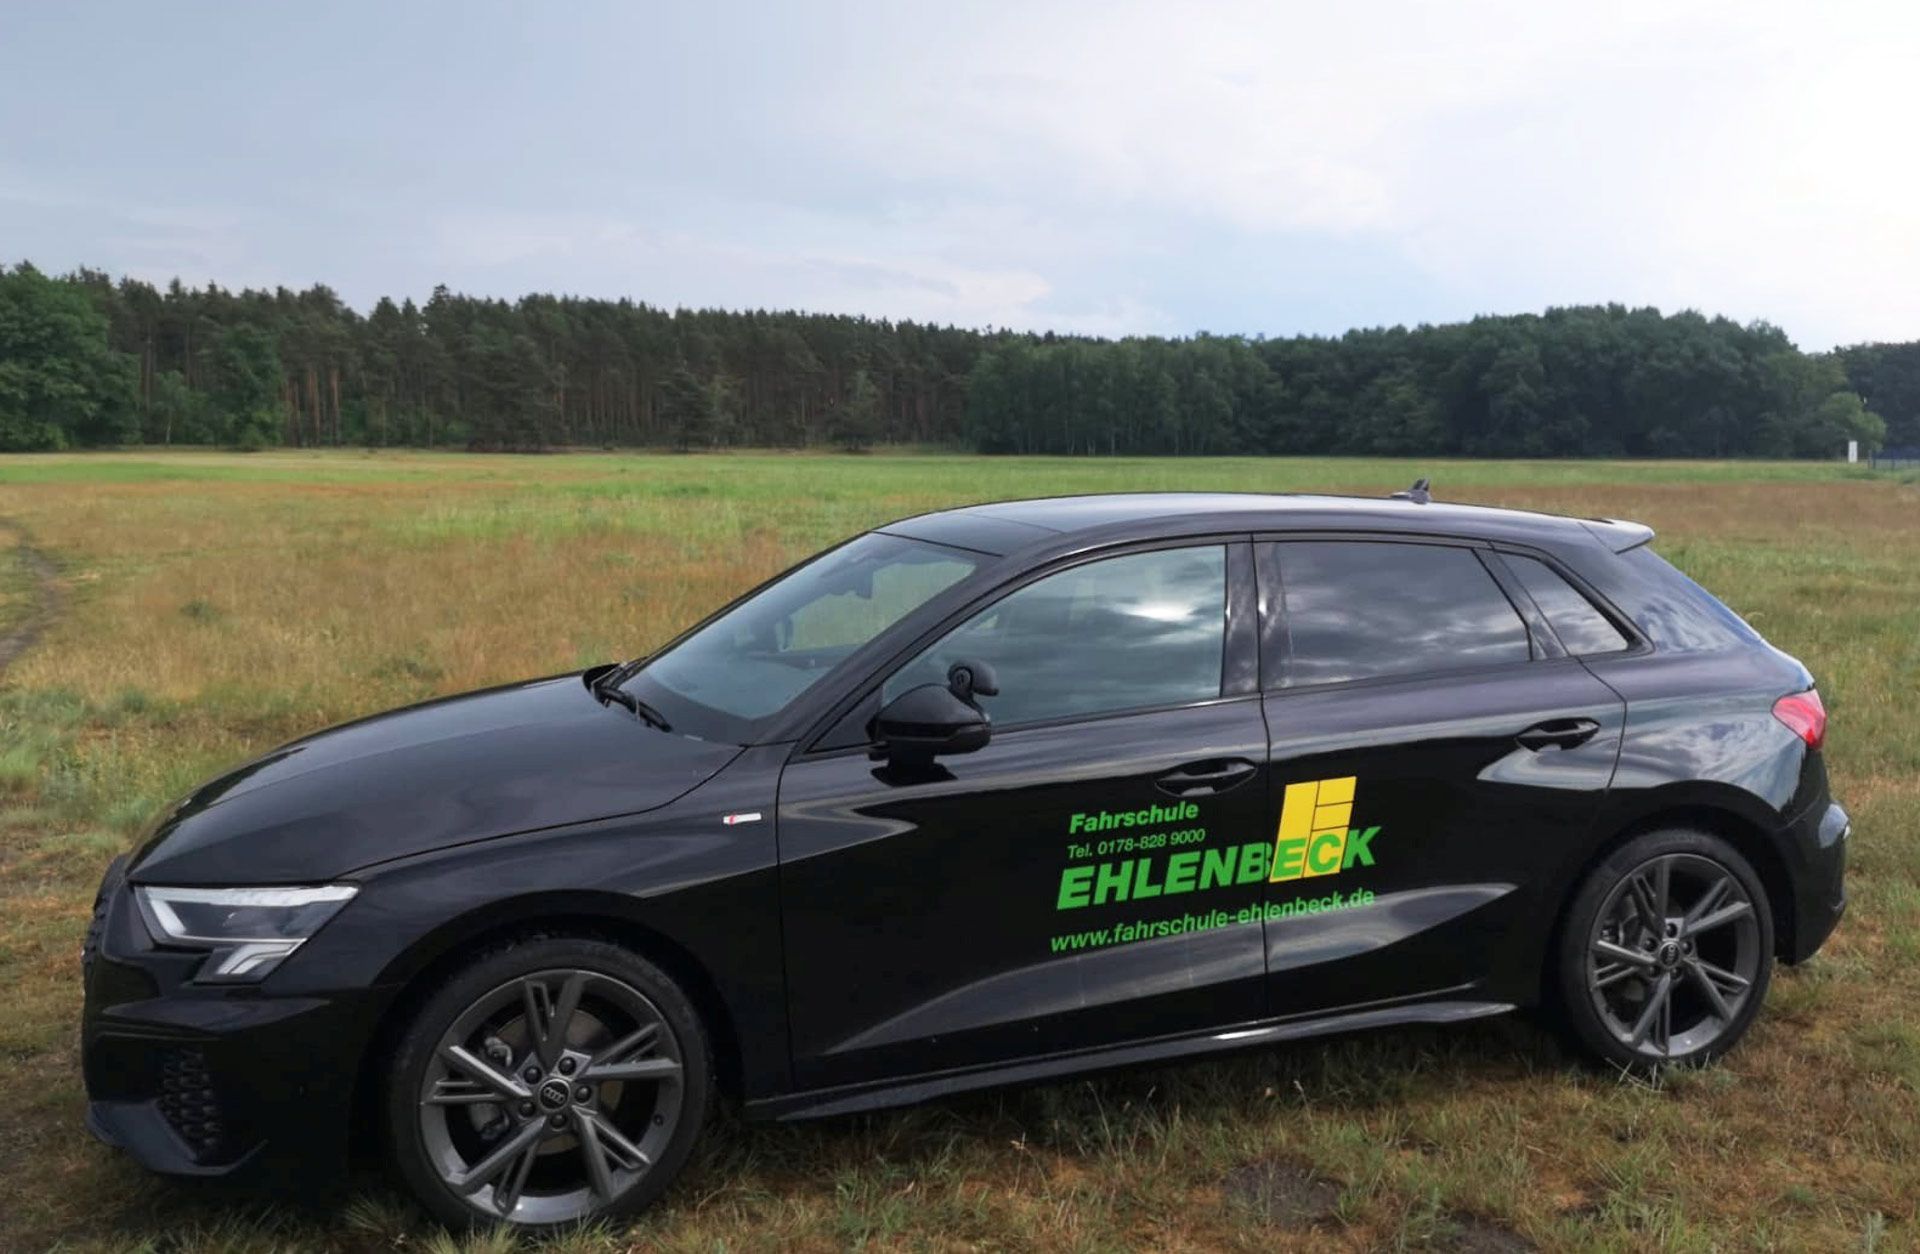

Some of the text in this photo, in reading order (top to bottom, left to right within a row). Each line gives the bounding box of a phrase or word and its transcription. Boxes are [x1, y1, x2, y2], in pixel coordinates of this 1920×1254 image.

[1069, 801, 1199, 834] Fahrschule
[1057, 826, 1381, 910] EHLENBECK
[1067, 829, 1206, 859] Tel. 0178-828 9000
[1050, 888, 1375, 952] www.fahrschule-ehlenbeck.de
